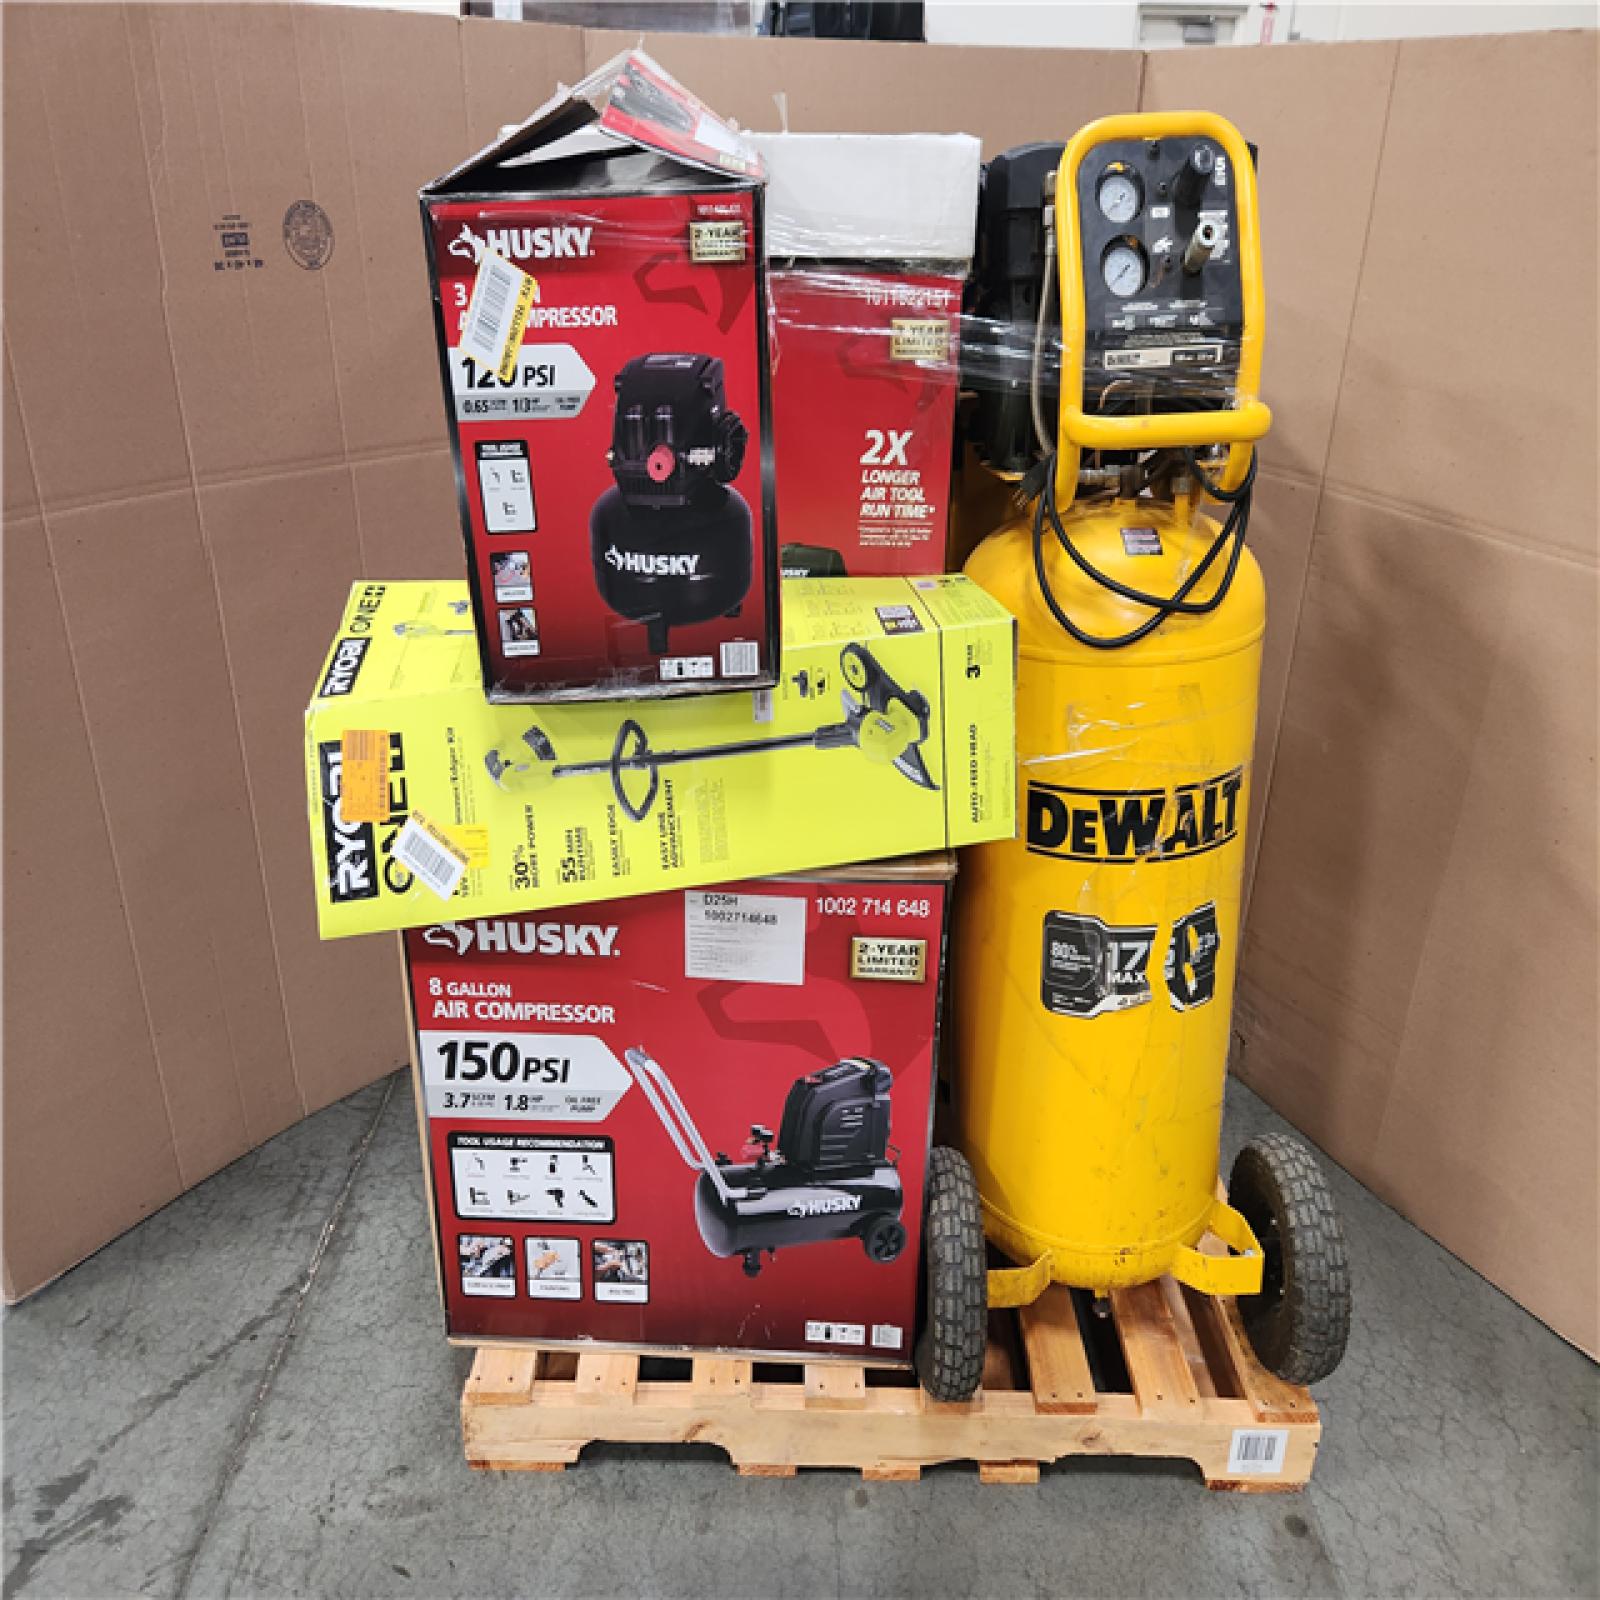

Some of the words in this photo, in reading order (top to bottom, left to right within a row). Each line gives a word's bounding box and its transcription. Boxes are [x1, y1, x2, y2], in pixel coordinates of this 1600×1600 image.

[486, 227, 593, 259] HUSKY
[454, 282, 467, 306] 3
[526, 305, 618, 329] MPRESSOR
[462, 356, 517, 389] 12
[524, 364, 556, 388] PSI
[860, 430, 913, 465] 2X
[862, 470, 921, 486] LONGER
[860, 487, 888, 501] AIR
[890, 487, 926, 502] TOOL
[625, 553, 700, 576] HUSKY
[966, 665, 981, 679] 3
[560, 857, 577, 883] 55
[815, 897, 857, 916] 1002
[862, 898, 891, 917] 714
[897, 899, 931, 919] 648
[475, 919, 619, 957] HUSKY
[858, 942, 921, 956] 2-YEAR
[858, 956, 921, 967] LIMITED
[429, 977, 443, 996] 8
[446, 982, 512, 999] GALLON
[433, 1000, 471, 1019] AIR
[474, 1001, 616, 1025] COMPRESSOR
[437, 1040, 520, 1083] 150
[522, 1057, 571, 1083] PSI
[443, 1092, 471, 1109] 3.7
[504, 1094, 530, 1111] 1.8
[805, 1195, 863, 1216] HUSKY
